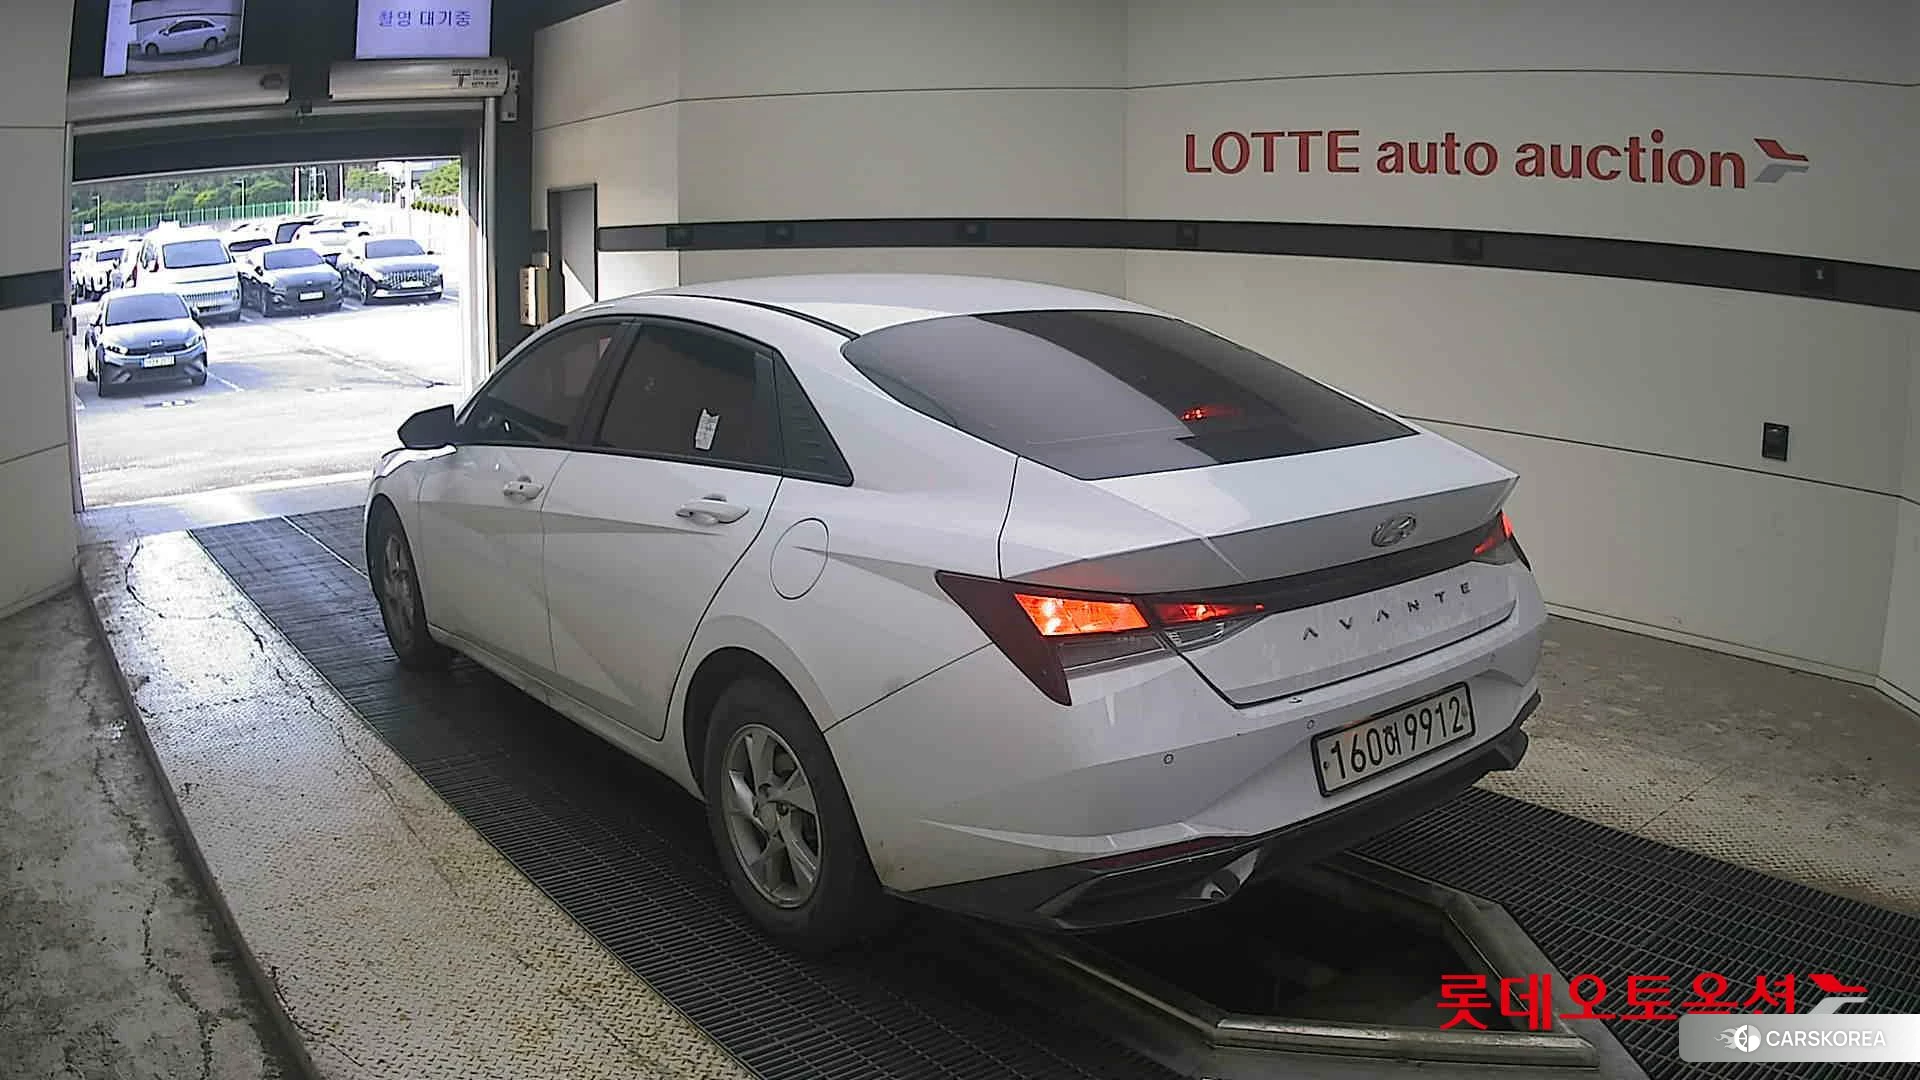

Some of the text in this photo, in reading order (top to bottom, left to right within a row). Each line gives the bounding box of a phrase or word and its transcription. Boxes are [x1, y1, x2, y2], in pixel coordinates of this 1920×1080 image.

[420, 10, 472, 27] 대기중
[1186, 129, 1745, 188] LOTTE auto auction
[1303, 582, 1471, 640] AVANTE
